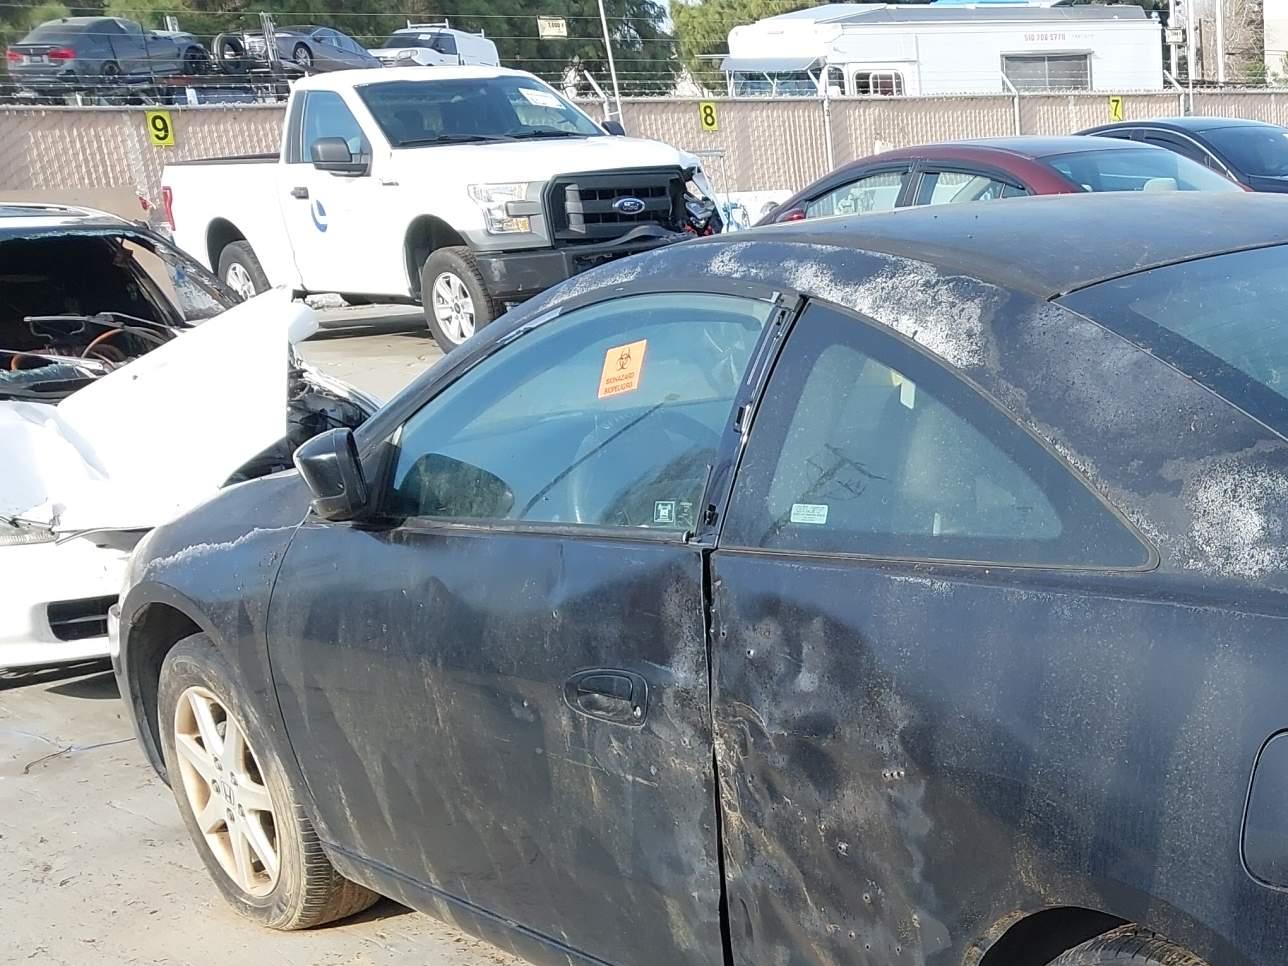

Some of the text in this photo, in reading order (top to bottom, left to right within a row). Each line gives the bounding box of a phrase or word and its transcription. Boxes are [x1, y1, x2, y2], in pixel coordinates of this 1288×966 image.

[703, 105, 715, 126] 8
[1111, 99, 1120, 116] 7
[151, 114, 169, 141] 9
